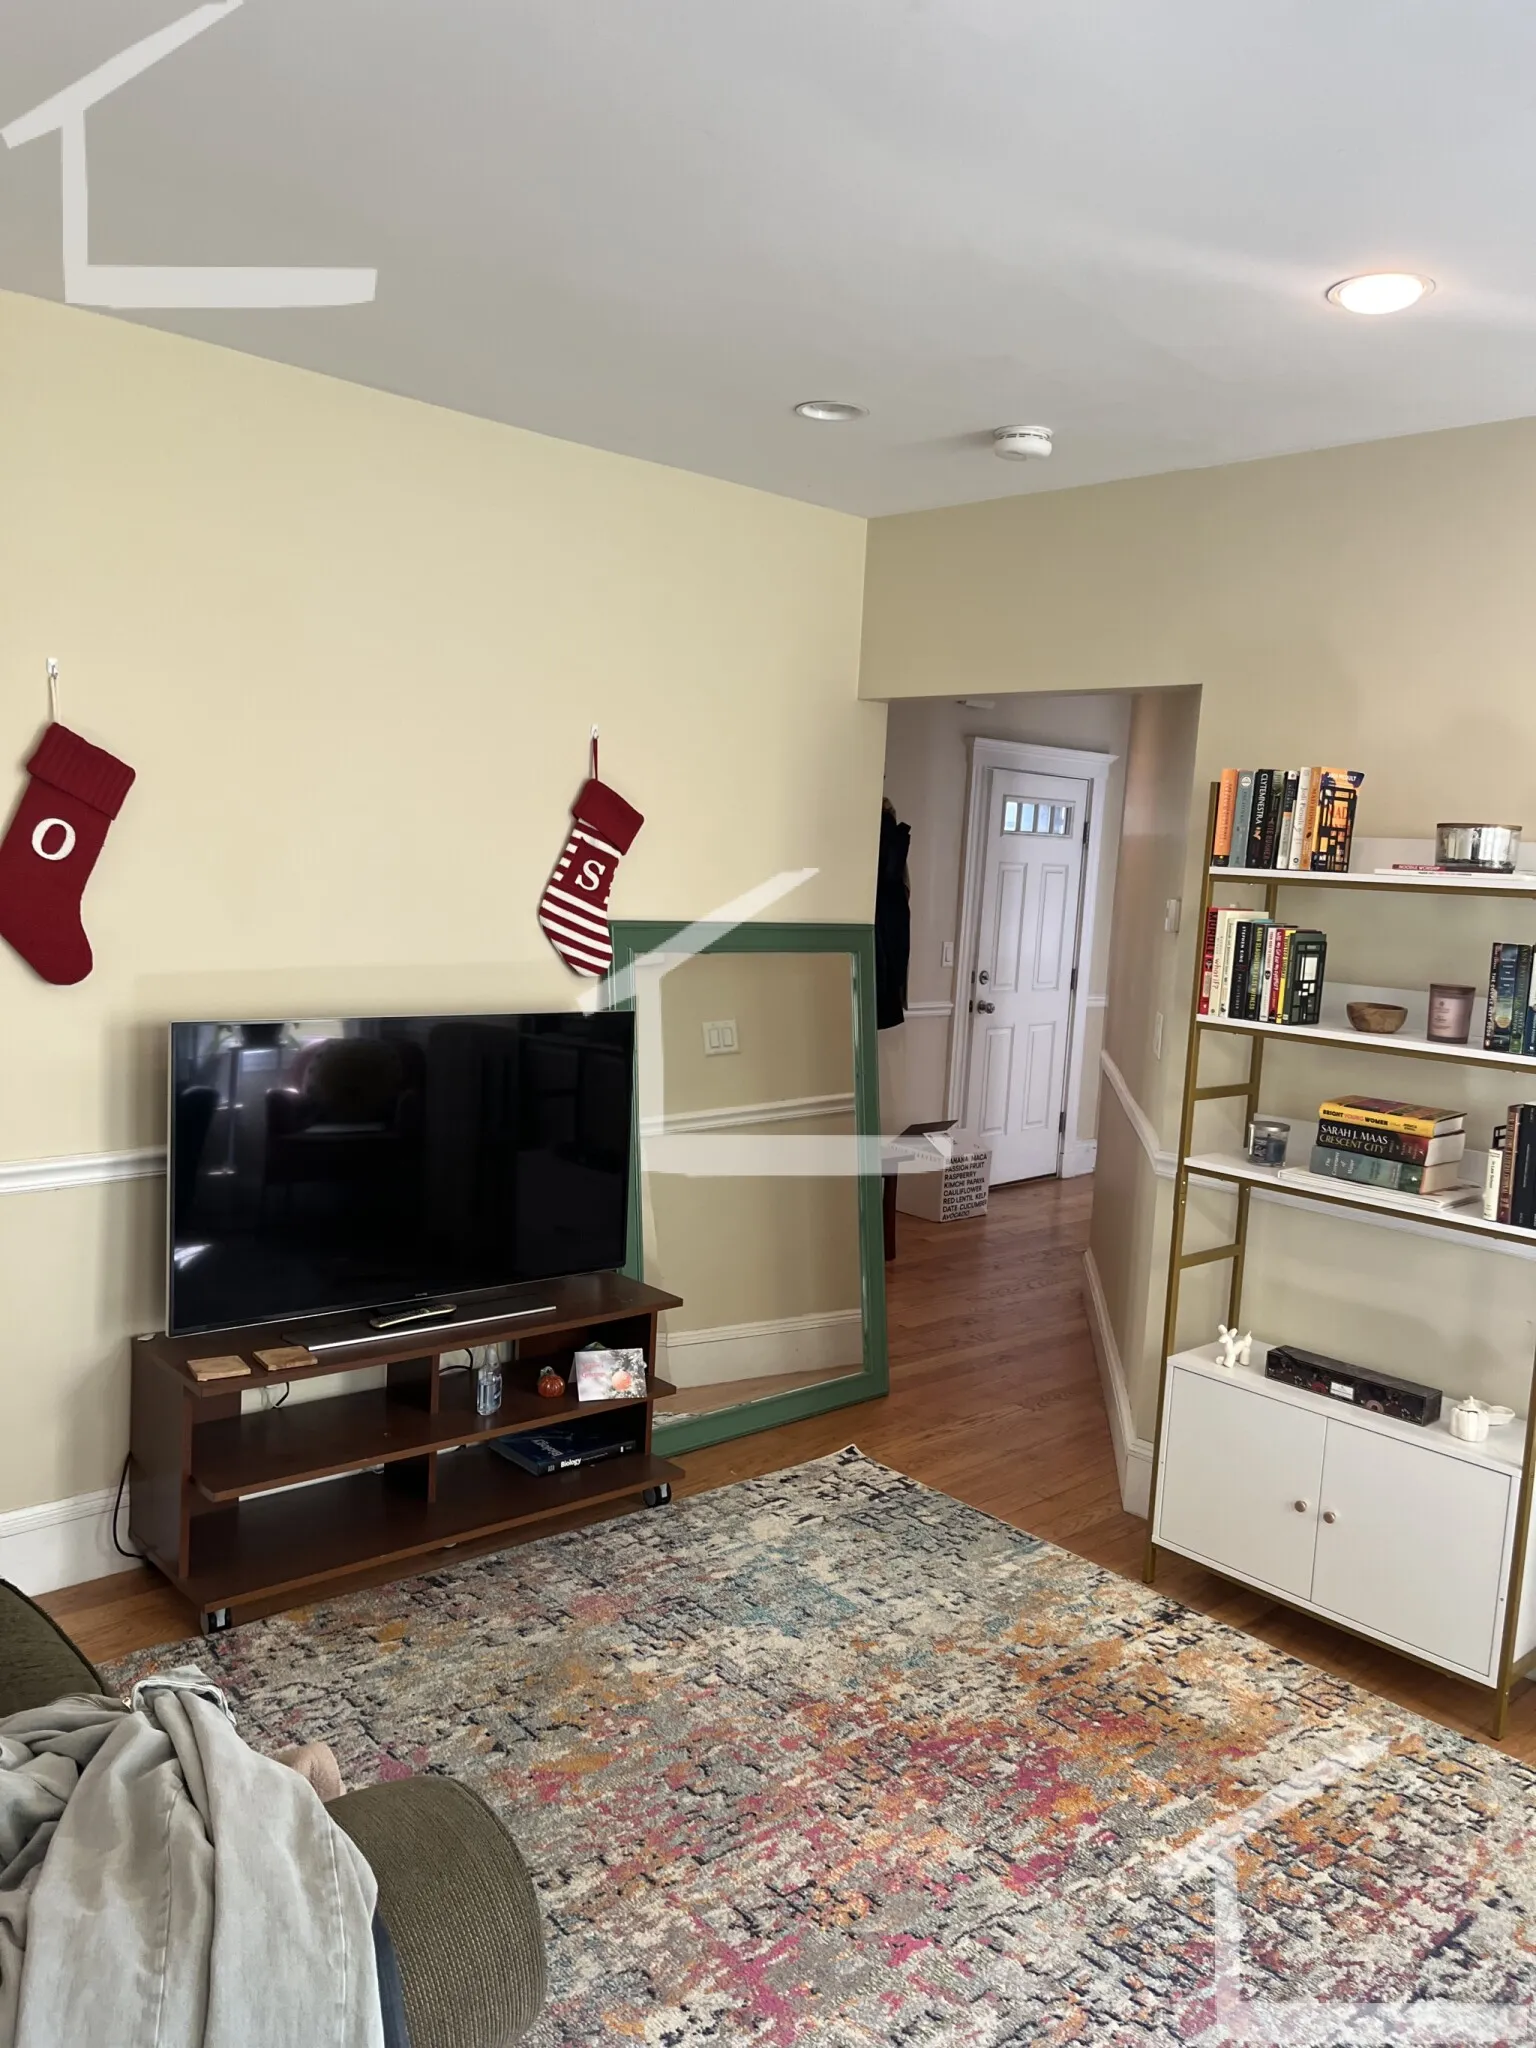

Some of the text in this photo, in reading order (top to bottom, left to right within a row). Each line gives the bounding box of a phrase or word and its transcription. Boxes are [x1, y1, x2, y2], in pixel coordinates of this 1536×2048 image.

[1254, 773, 1268, 824] CLYTEMNESTRA
[32, 818, 76, 860] O
[575, 860, 605, 891] S
[1213, 958, 1221, 977] what
[1248, 988, 1256, 1009] WITNESS
[1365, 1117, 1388, 1125] WOMEN
[1321, 1125, 1351, 1136] SARAH
[1361, 1132, 1388, 1144] MAAS
[1320, 1135, 1361, 1148] CRESCENT
[1364, 1143, 1384, 1153] CITY
[945, 1171, 976, 1181] RASPBERRY
[944, 1186, 982, 1196] CAULIFLOWER
[956, 1195, 973, 1203] LENTIL
[942, 1210, 970, 1220] AVOCADO
[561, 1458, 581, 1468] Biology
